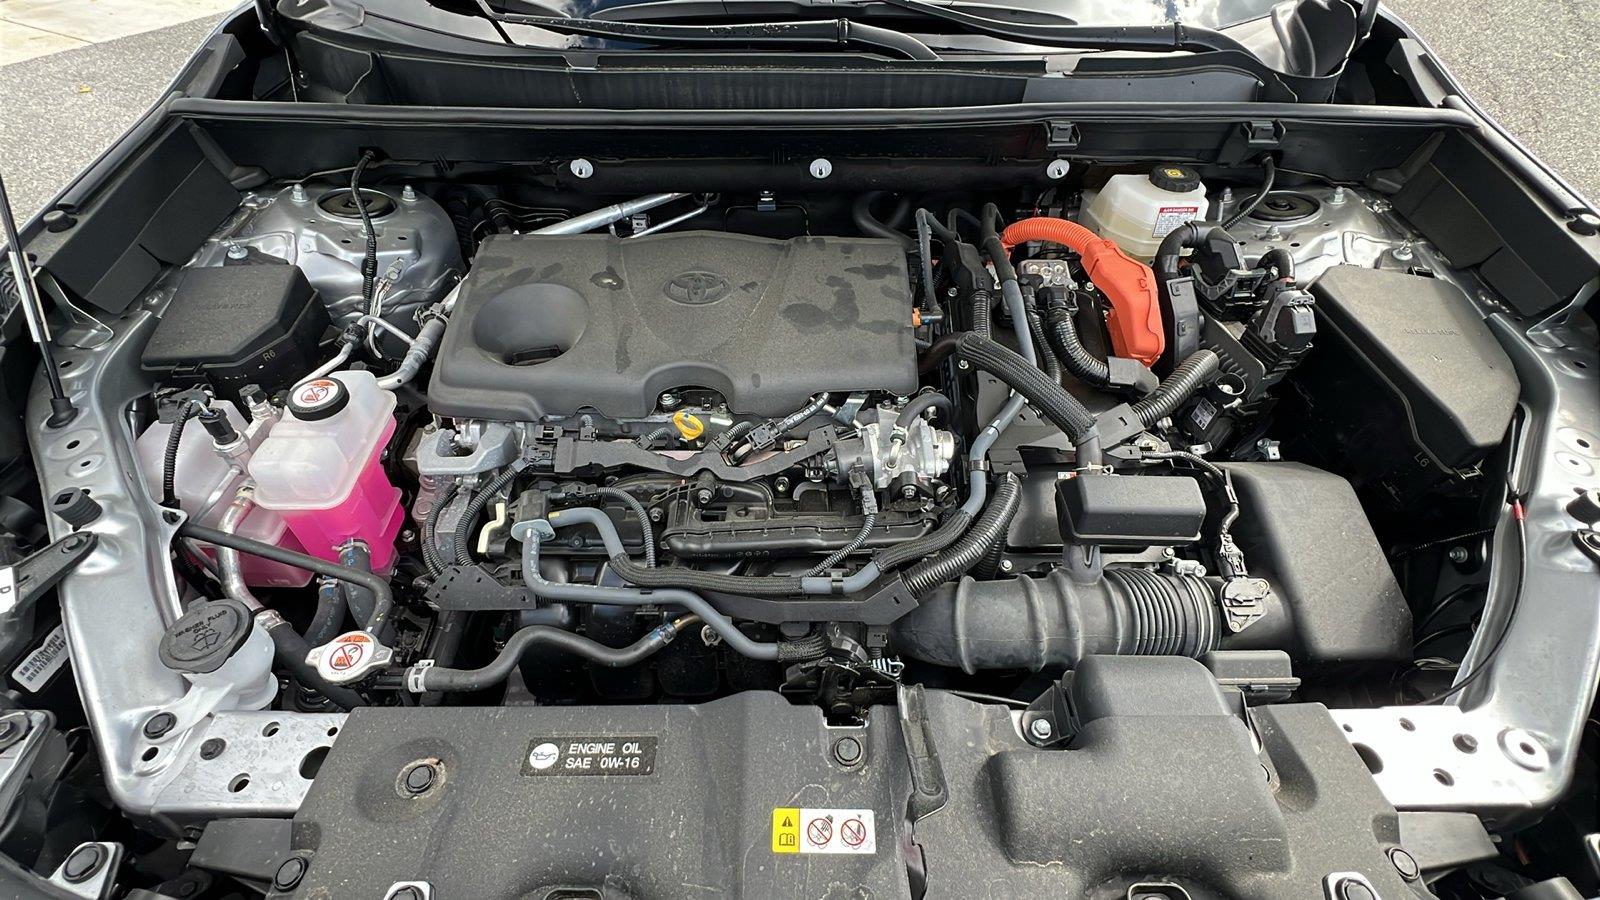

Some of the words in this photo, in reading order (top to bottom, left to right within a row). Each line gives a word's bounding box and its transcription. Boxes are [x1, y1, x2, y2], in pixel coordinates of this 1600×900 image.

[262, 349, 276, 361] R6
[1414, 451, 1430, 467] L6
[568, 743, 615, 754] ENGINE
[622, 743, 643, 754] OIL
[565, 757, 592, 768] SAE
[600, 757, 640, 768] 0W-16
